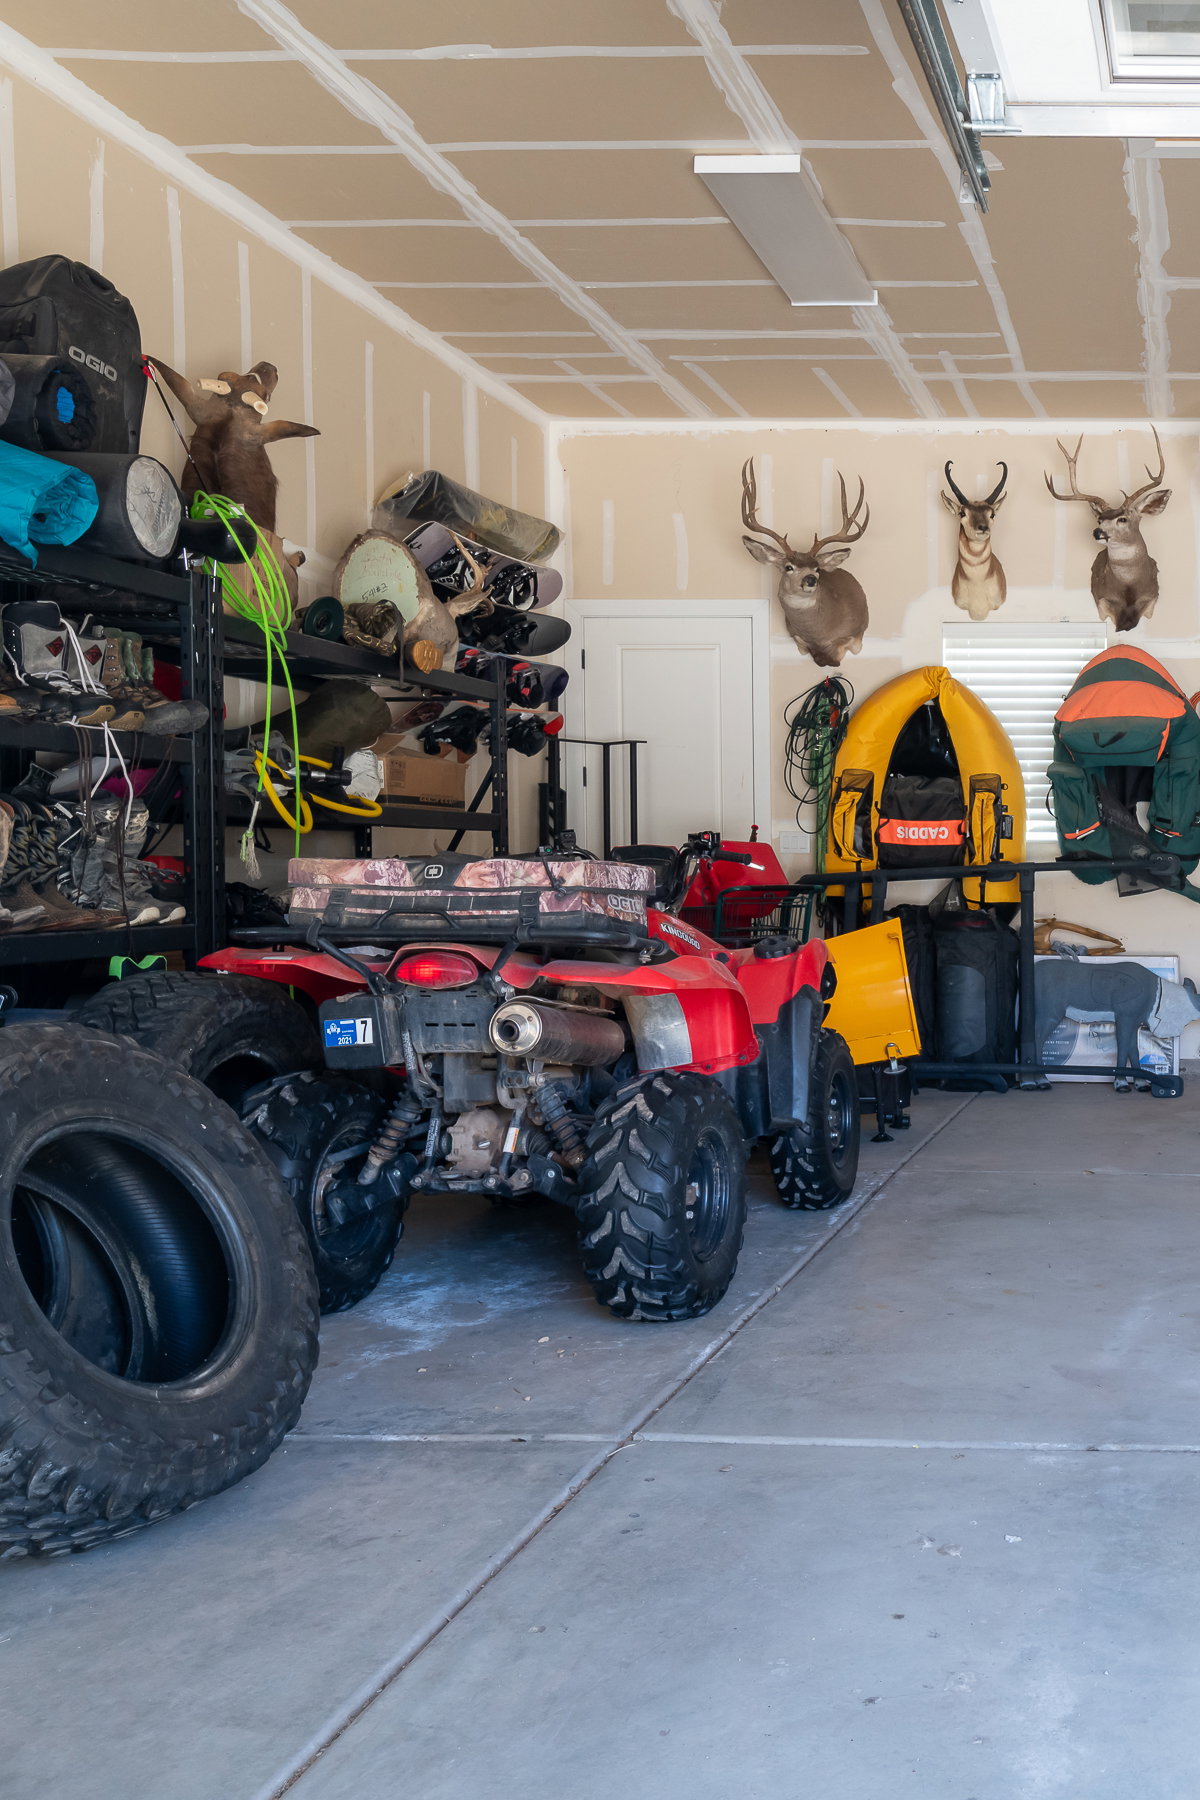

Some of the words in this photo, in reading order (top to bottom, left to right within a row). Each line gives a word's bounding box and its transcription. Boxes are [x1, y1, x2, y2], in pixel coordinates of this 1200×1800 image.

[69, 346, 118, 382] OGIO
[896, 826, 949, 840] CADDIS
[660, 923, 701, 950] KINGQUAD
[337, 1036, 352, 1045] 2021
[361, 1020, 368, 1043] 7
